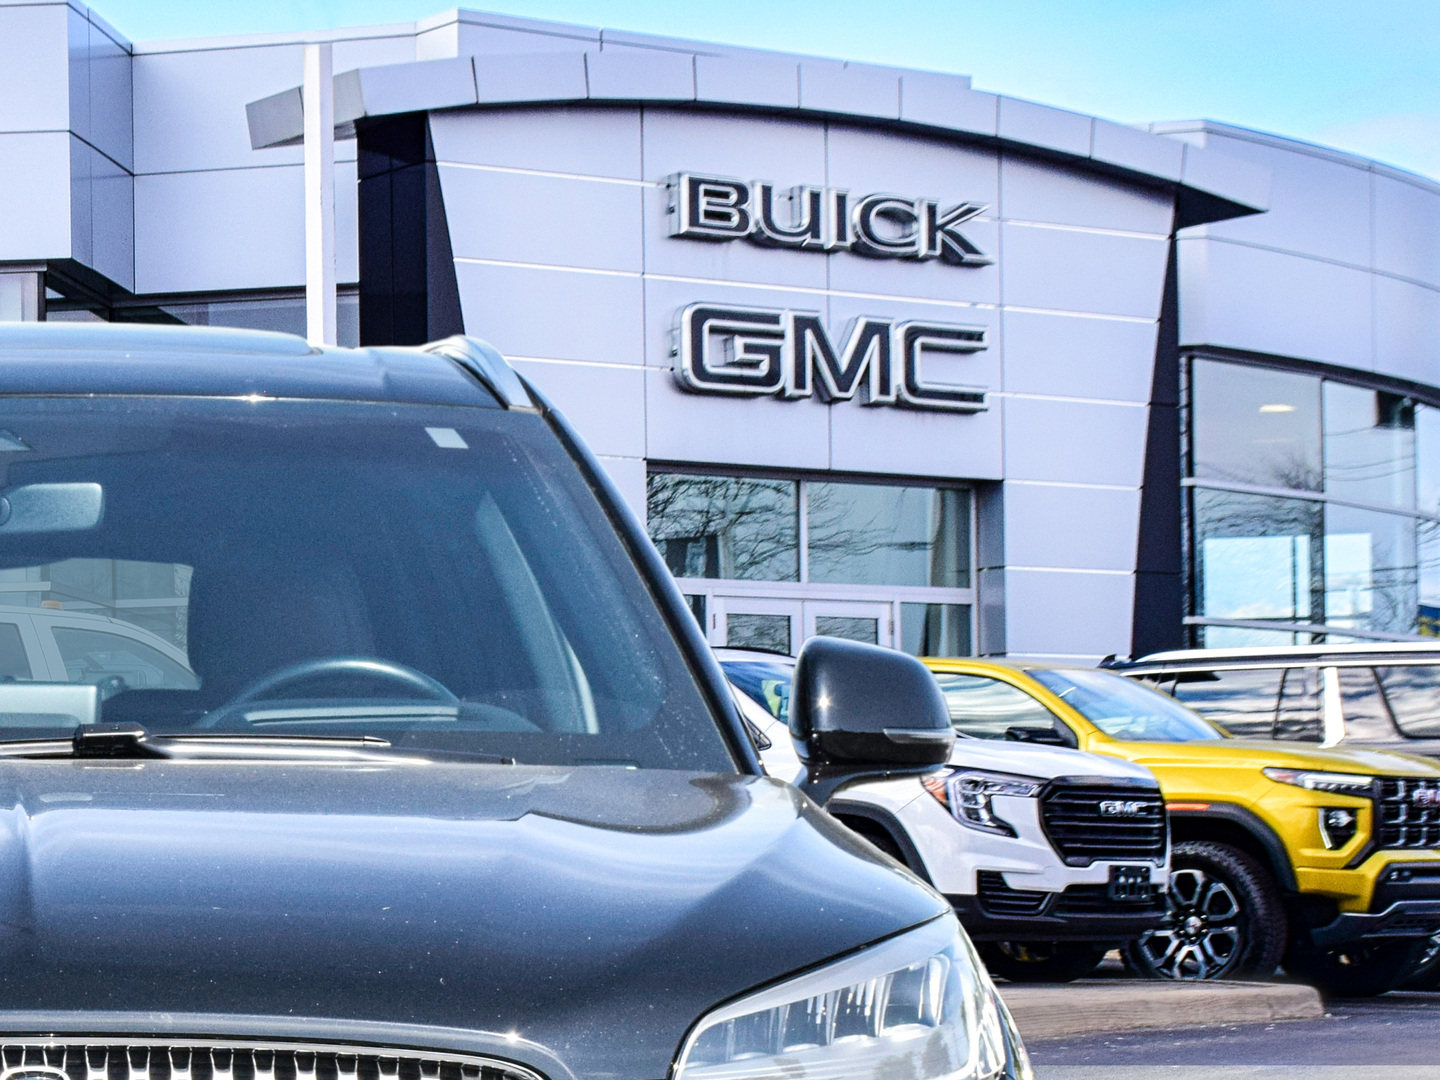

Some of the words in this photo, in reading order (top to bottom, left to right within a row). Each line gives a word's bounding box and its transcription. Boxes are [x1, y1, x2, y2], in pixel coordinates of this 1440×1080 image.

[668, 171, 996, 266] BUICK
[671, 301, 991, 412] GMC
[1099, 800, 1149, 818] GMC
